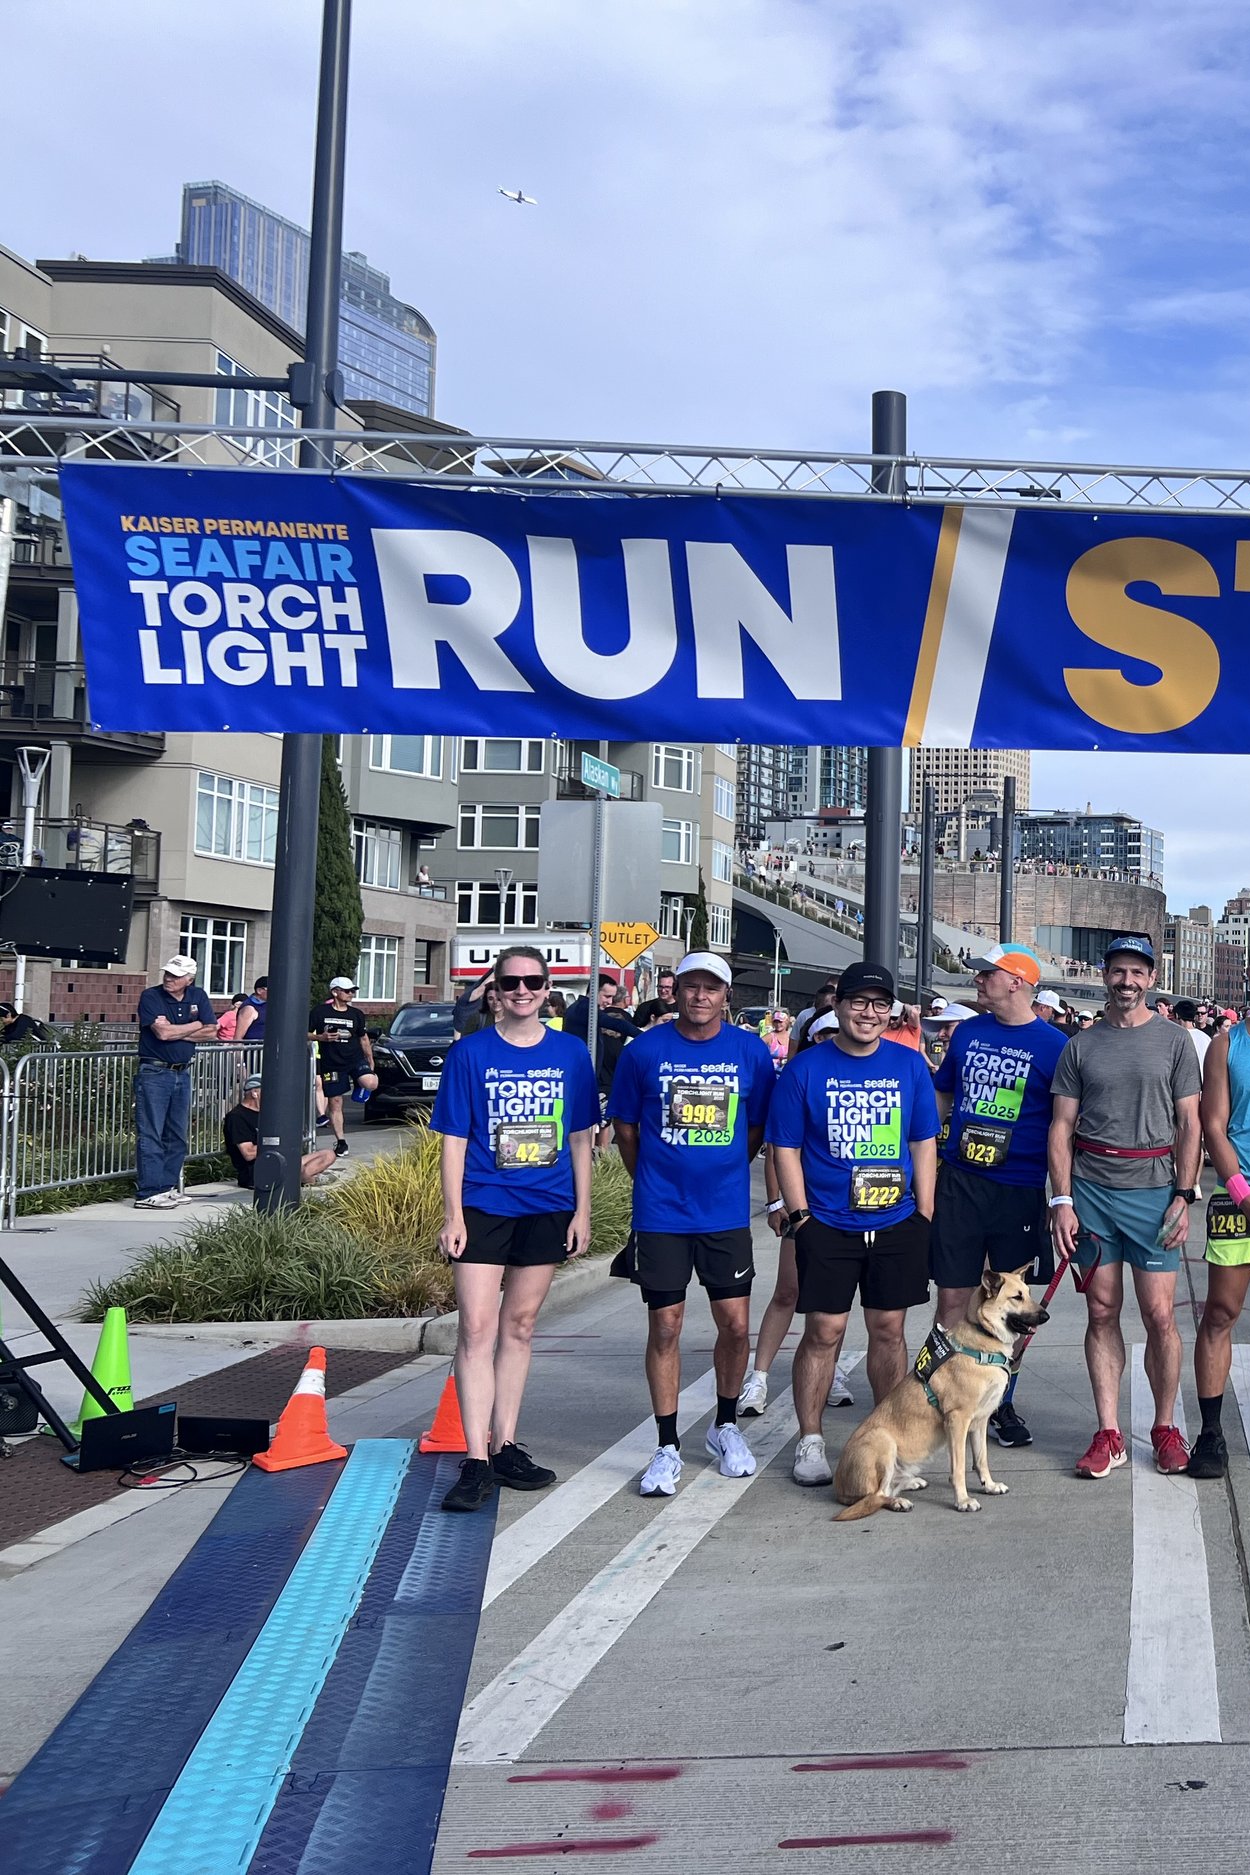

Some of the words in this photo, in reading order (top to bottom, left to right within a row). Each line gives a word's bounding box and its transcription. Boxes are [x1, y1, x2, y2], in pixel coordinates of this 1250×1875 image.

[120, 515, 201, 534] KAISER
[203, 518, 349, 541] PERMANENTE
[124, 535, 357, 582] SEAFAIR
[129, 580, 364, 631] TORCH
[370, 528, 842, 700] RUN
[138, 630, 368, 687] LIGHT
[583, 756, 609, 789] Alaskan
[599, 932, 650, 945] OUTLET
[1000, 1046, 1034, 1061] seafair
[527, 1068, 564, 1079] seafair
[700, 1063, 739, 1073] seafair
[965, 1051, 1031, 1078] TORCH
[864, 1079, 900, 1088] seafair
[961, 1066, 1016, 1088] LIGHT
[485, 1081, 564, 1099] TORCH
[826, 1090, 901, 1107] TORCH
[962, 1081, 997, 1102] RUN
[487, 1098, 554, 1117] LIGHT
[681, 1104, 716, 1124] 998
[827, 1107, 890, 1124] LIGHT
[959, 1096, 978, 1114] 5K
[979, 1102, 1015, 1119] 2025
[660, 1128, 688, 1145] 5K
[693, 1130, 731, 1143] 2025
[827, 1125, 872, 1141] RUN
[515, 1143, 540, 1162] 42
[829, 1142, 855, 1159] 5K
[860, 1144, 896, 1157] 2025
[966, 1142, 996, 1163] 823
[857, 1186, 900, 1206] 1222
[1210, 1214, 1247, 1233] 1249
